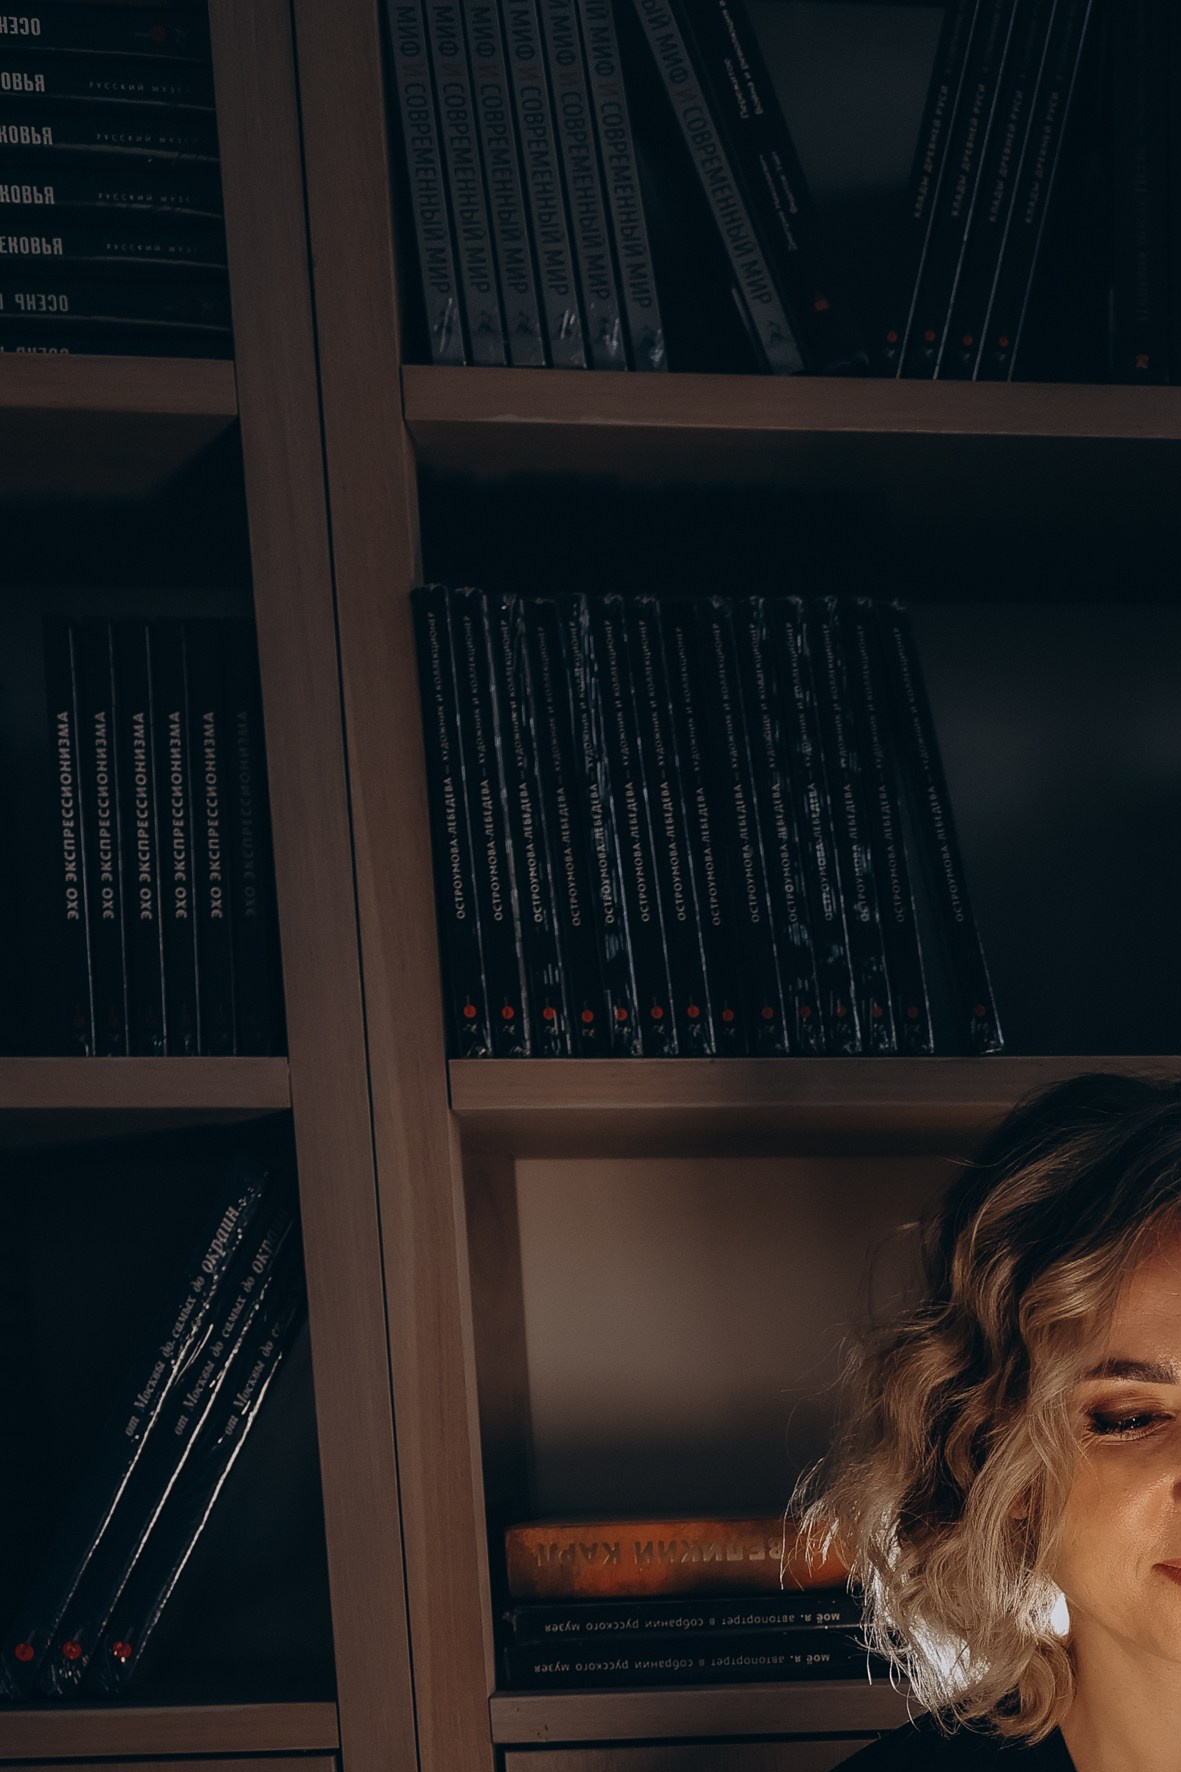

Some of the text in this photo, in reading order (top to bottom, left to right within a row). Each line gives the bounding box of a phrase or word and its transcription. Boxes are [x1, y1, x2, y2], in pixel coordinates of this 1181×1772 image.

[397, 6, 421, 58] МИФ
[433, 6, 459, 58] МИФ
[470, 6, 496, 58] МИФ
[510, 9, 536, 61] МИФ
[550, 15, 576, 67] МИФ
[589, 26, 614, 77] МИФ
[404, 82, 447, 242] СОВРЕМЕННЫЙ
[443, 82, 487, 242] СОВРЕМЕННЫЙ
[481, 83, 524, 243] СОВРЕМЕННЫЙ
[520, 86, 565, 245] СОВРЕМЕННЫЙ
[560, 91, 605, 250] СОВРЕМЕННЫЙ
[600, 101, 646, 258] СОВРЕМЕННЫЙ
[655, 33, 689, 84] МИФ
[682, 105, 756, 259] СОВРЕМЕННЫЙ
[740, 260, 772, 304] МИР
[425, 247, 450, 293] МИР
[464, 247, 490, 294] МИР
[503, 247, 529, 295] МИР
[543, 249, 569, 296] МИР
[584, 254, 610, 301] МИР
[626, 262, 652, 309] МИР
[14, 292, 70, 313] ОСЕНЬ
[55, 710, 80, 921] ЭХО ЭКСПРЕССИОНИЗМА
[93, 710, 115, 921] ЭХО ЭКСПРЕССИОНИЗМА
[131, 711, 153, 921] ЭХО ЭКСПРЕССИОНИЗМА
[168, 710, 189, 920] ЭХО ЭКСПРЕССИОНИЗМА
[202, 710, 224, 920] ЭХО ЭКСПРЕССИОНИЗМА
[133, 1359, 166, 1413] Москвы
[182, 1359, 216, 1413] Москвы
[536, 1535, 781, 1572] ВЕЛИКИЙ КАРЛ
[544, 1623, 581, 1633] музея
[585, 1620, 640, 1632] русского
[644, 1618, 704, 1629] собрании
[720, 1614, 796, 1627] автопортрет
[534, 1663, 570, 1673] музея
[575, 1661, 630, 1672] русского
[634, 1659, 694, 1670] собрании
[710, 1655, 785, 1667] автопортрет
